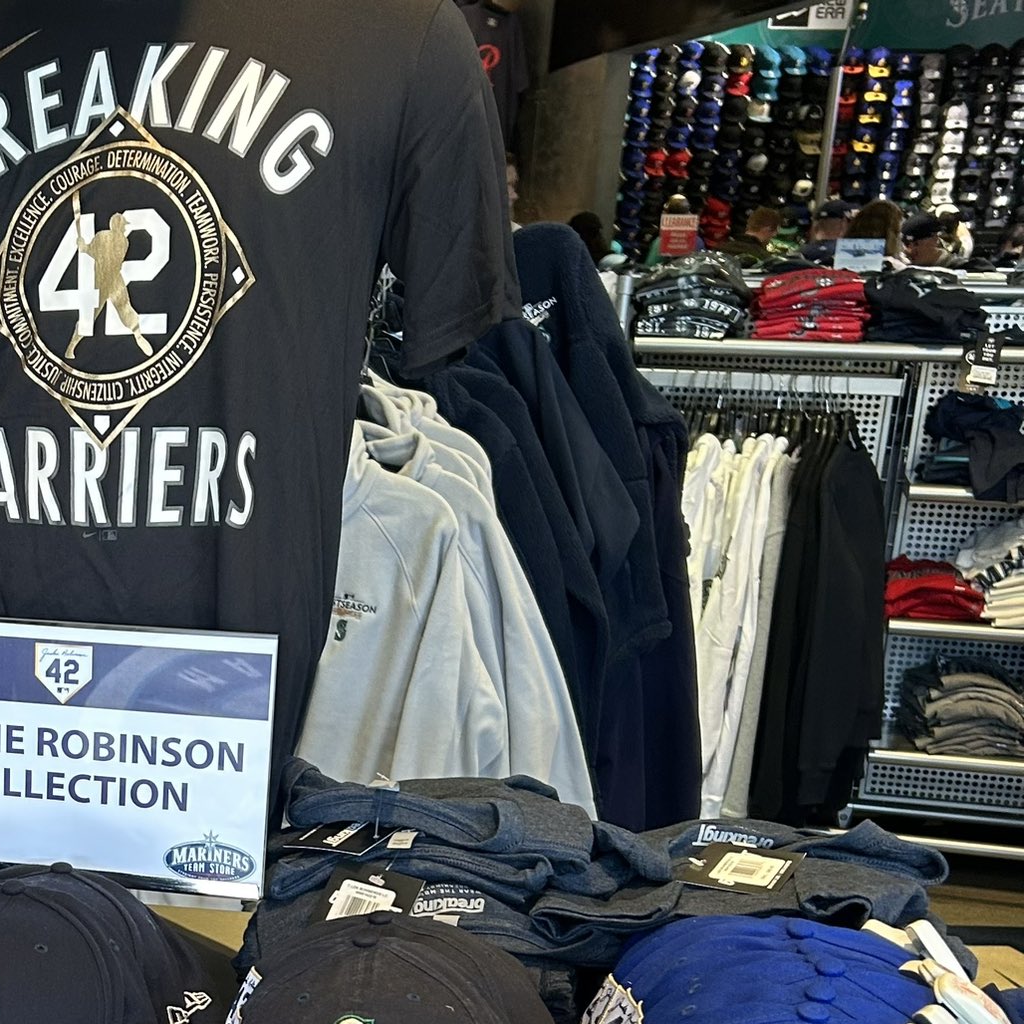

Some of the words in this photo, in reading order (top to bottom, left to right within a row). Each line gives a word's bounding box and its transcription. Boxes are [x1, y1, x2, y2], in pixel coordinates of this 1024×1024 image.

[815, 7, 845, 19] ERA
[50, 156, 104, 195] COURAGE.
[107, 149, 188, 198] DETERMINATION.
[184, 189, 220, 269] TEAMWORK.
[38, 207, 172, 337] 42
[176, 272, 219, 355] PERSISTENCE.
[125, 350, 184, 397] INTEGRITY.
[45, 658, 80, 685] 42
[37, 727, 245, 773] ROBINSON
[171, 844, 250, 872] MARINERS
[183, 862, 205, 873] TEAM
[209, 863, 235, 876] STORE
